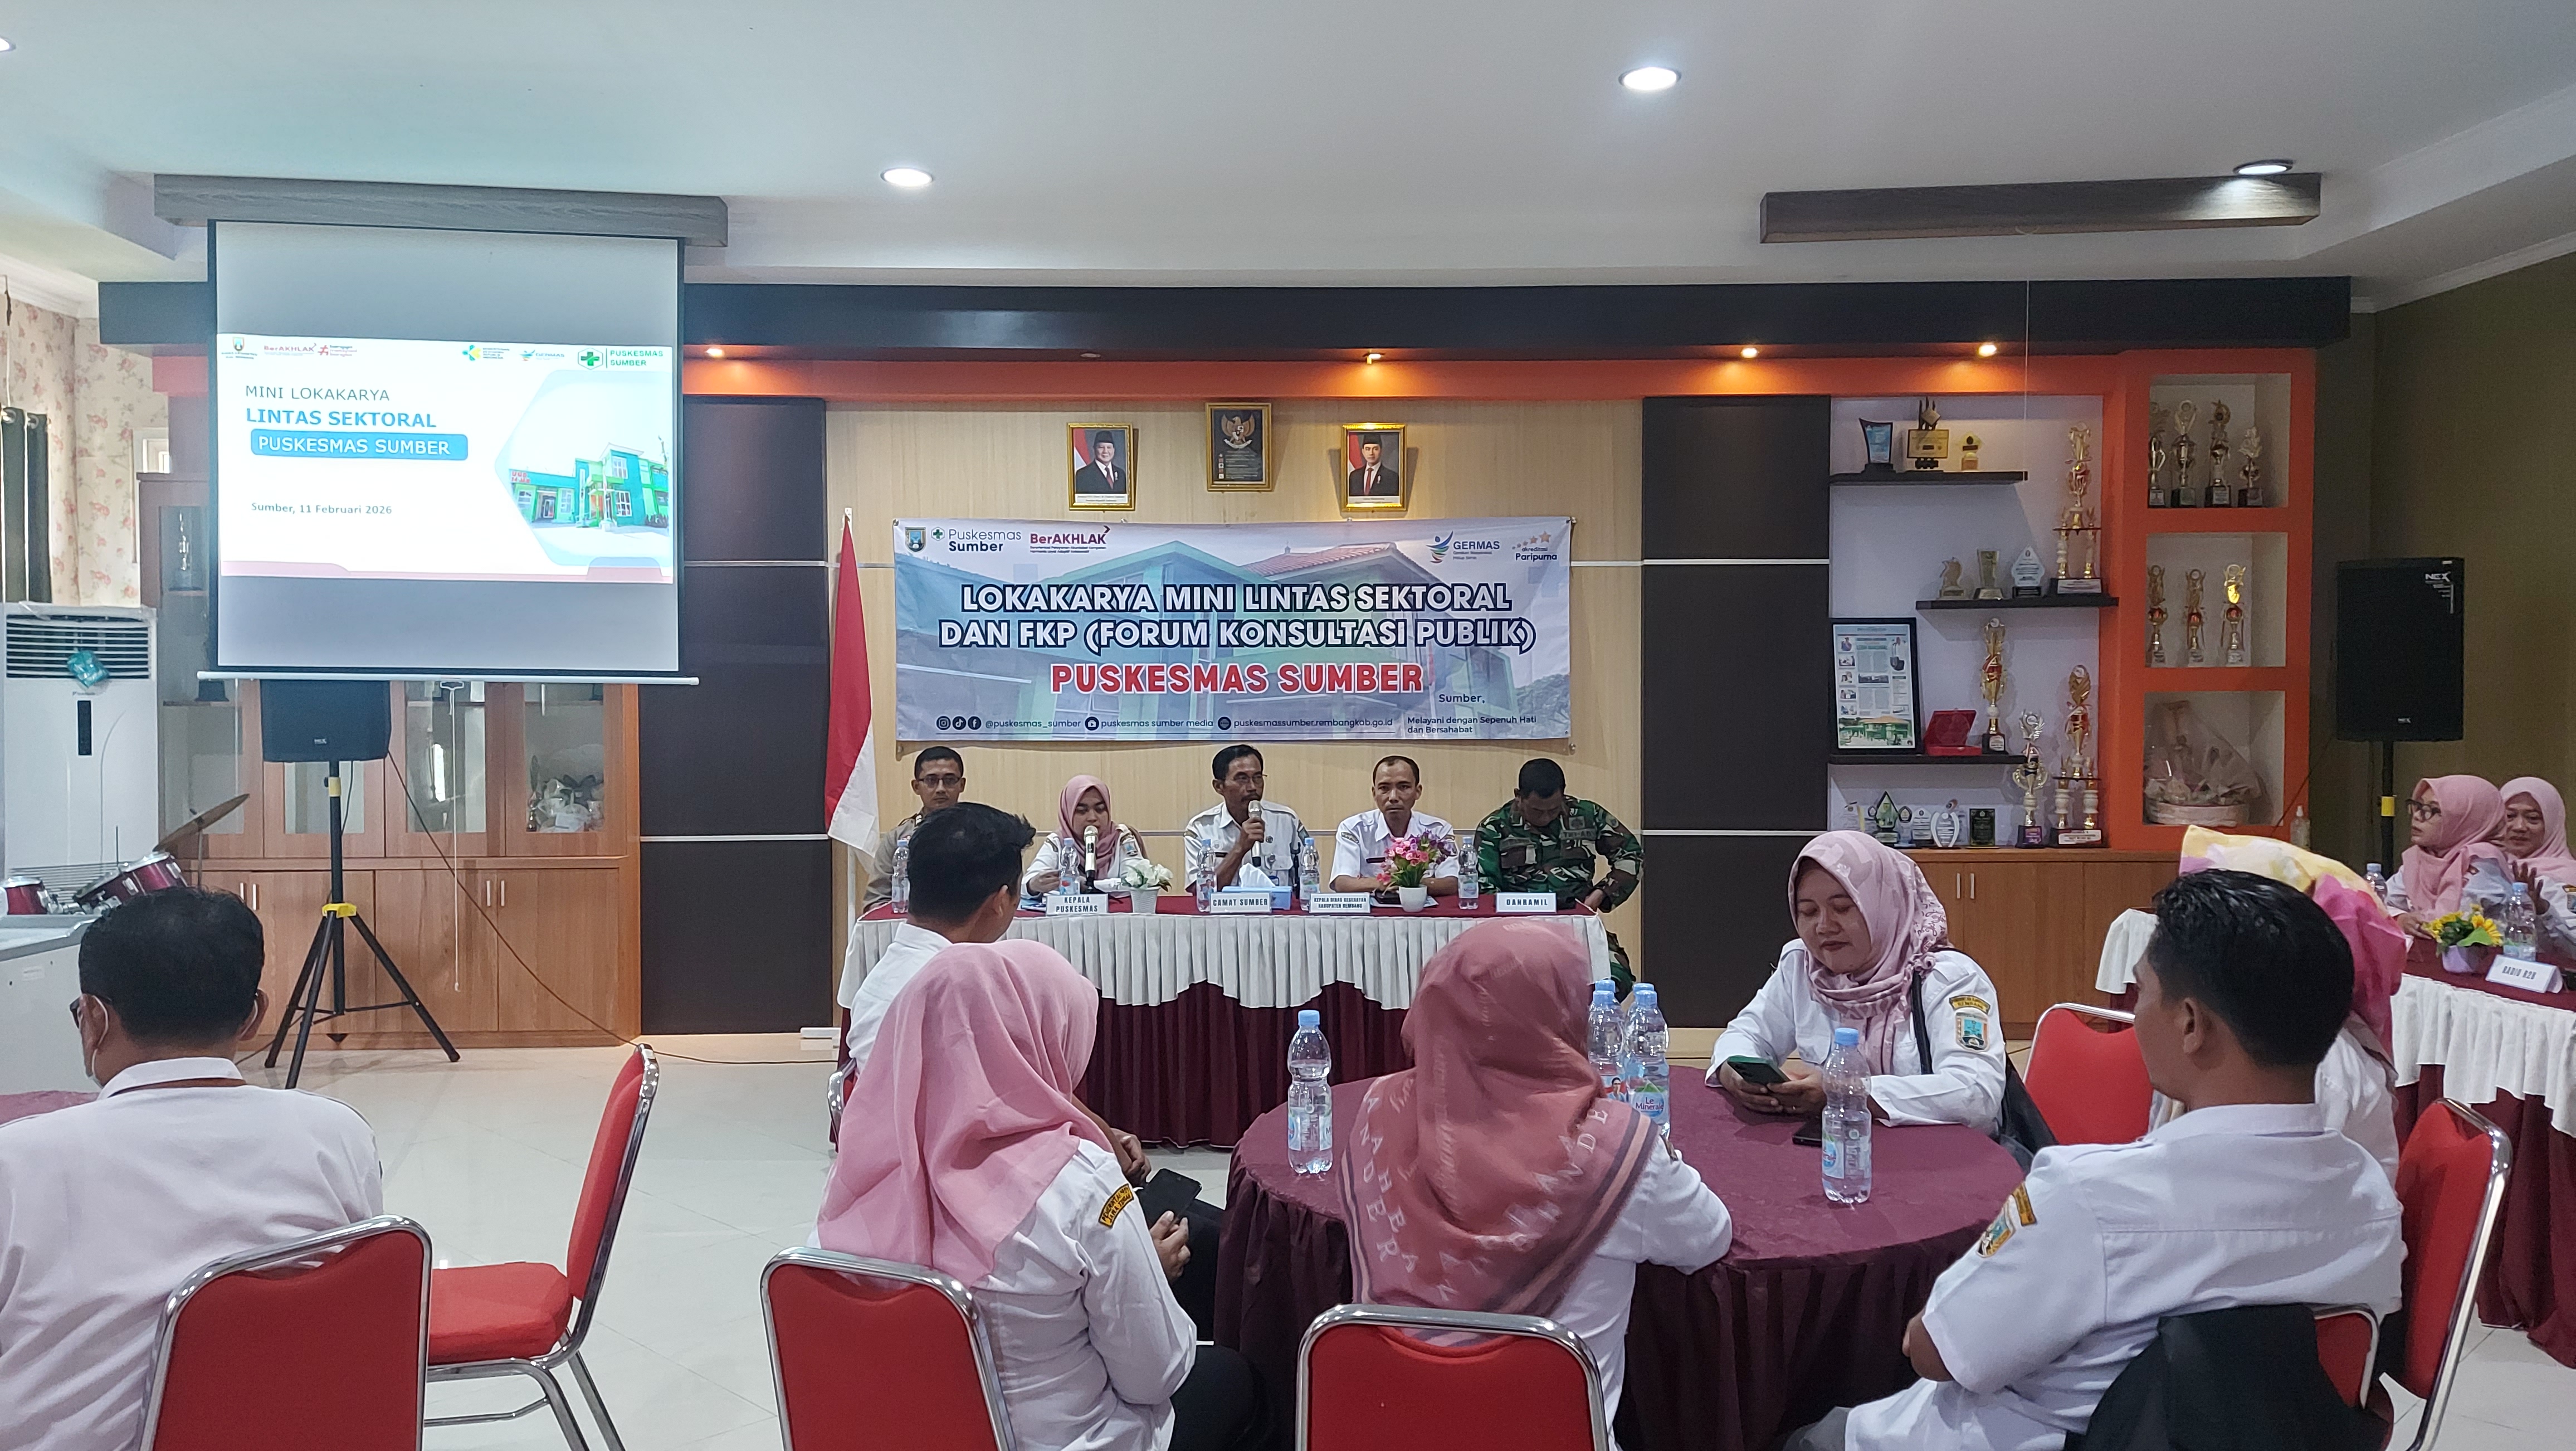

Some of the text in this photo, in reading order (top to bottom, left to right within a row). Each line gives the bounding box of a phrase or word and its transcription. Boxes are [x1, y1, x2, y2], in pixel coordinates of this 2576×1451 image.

[246, 385, 390, 401] MINI LOKAKARYA
[246, 408, 437, 427] LINTAS SEKTORAL
[258, 436, 451, 455] PUSKESMAS SUMBER
[251, 503, 392, 514] Sumber, 11 Februari 2026
[949, 529, 1021, 541] Puskesmas
[1030, 532, 1107, 544] BerAKHLAK
[949, 541, 1003, 552] Sumber
[1453, 541, 1500, 549] GERMAS
[1515, 553, 1557, 562] Paripurna
[962, 583, 1512, 612] LOKAKARYA MINI LINTAS SEKTORAL
[939, 617, 1536, 656] DAN FKP (FORUM KONSULTASI PUBLIK)
[1051, 663, 1424, 694] PUSKESMAS SUMBER
[1438, 694, 1485, 704] Sumber,
[985, 720, 1080, 729] @puskesmas_sumber
[1101, 720, 1149, 728] puskesmas
[1407, 717, 1444, 726] Melayani
[1446, 717, 1477, 725] dengan
[2502, 966, 2521, 976] RADIO
